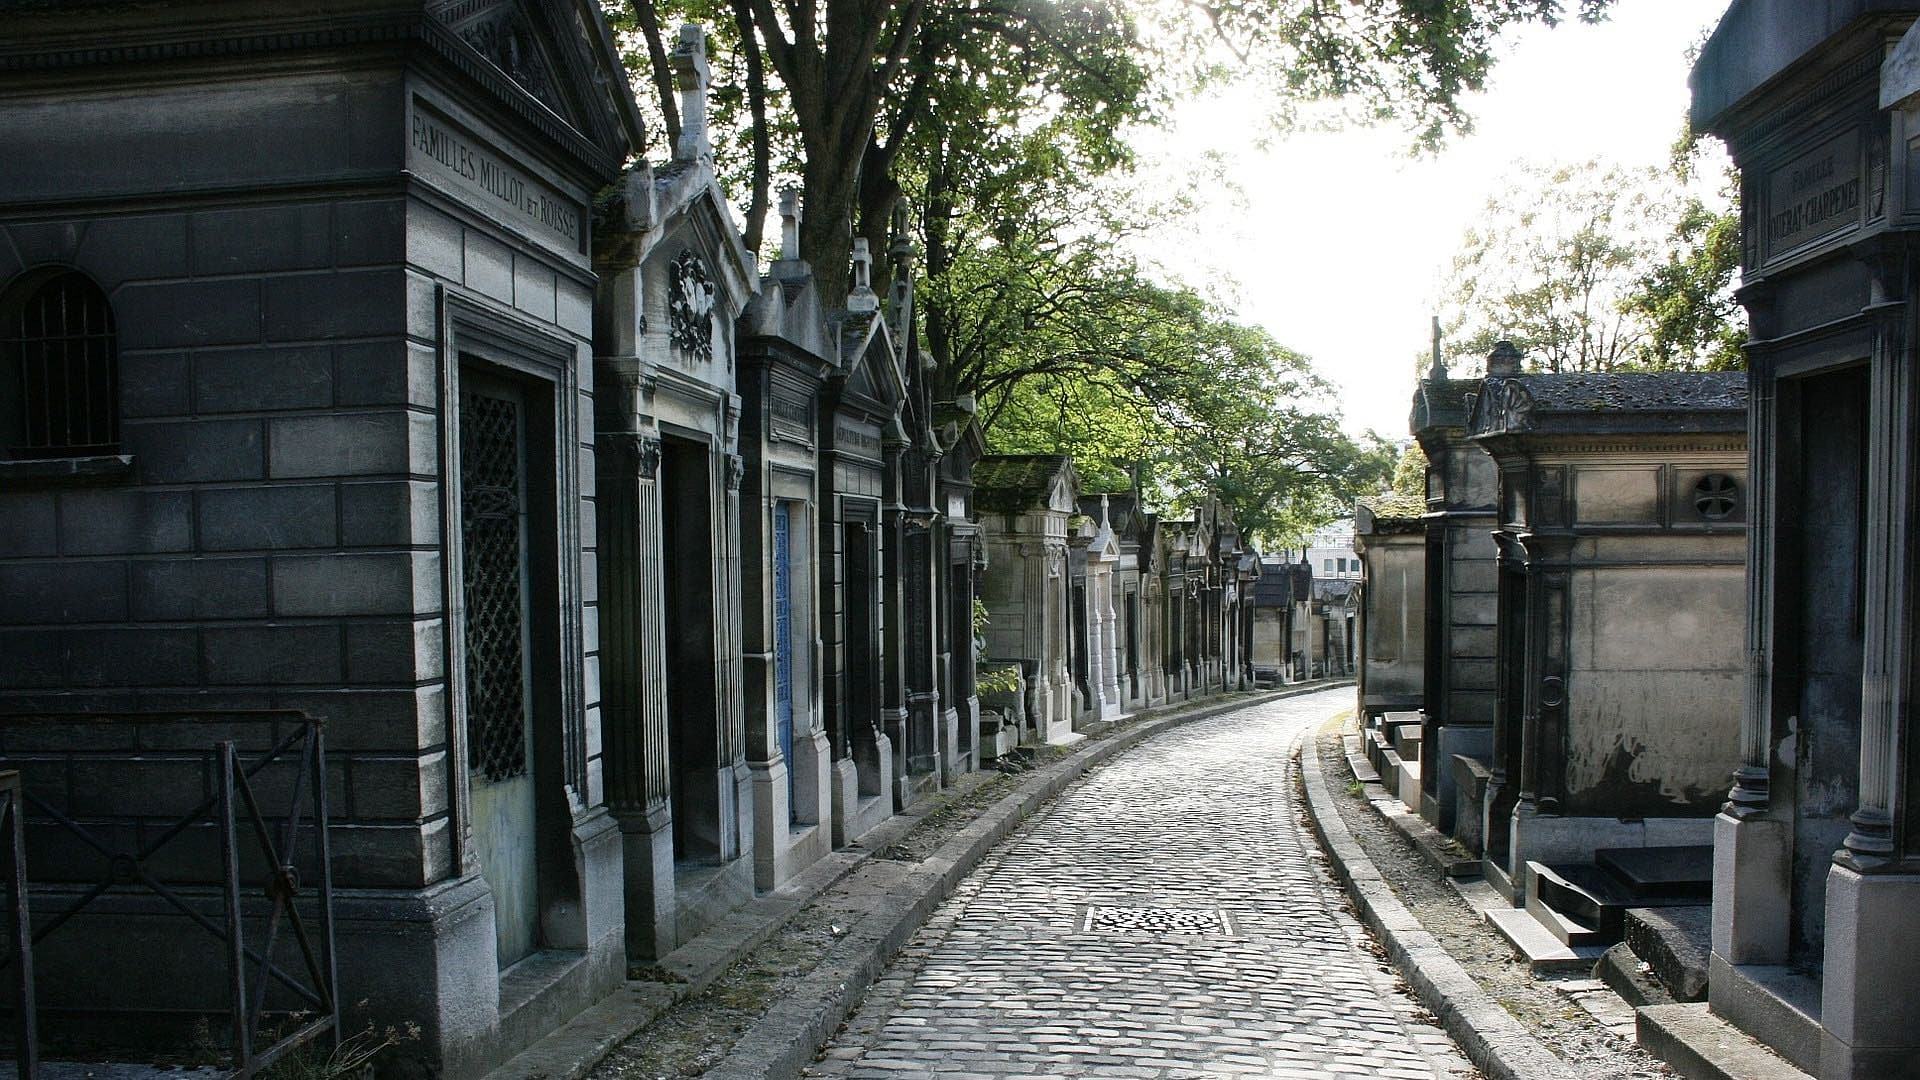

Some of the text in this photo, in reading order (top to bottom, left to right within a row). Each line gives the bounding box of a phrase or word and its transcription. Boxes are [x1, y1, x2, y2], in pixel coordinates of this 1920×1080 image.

[412, 115, 577, 241] FAMILLES MILLOT ET ROISSE
